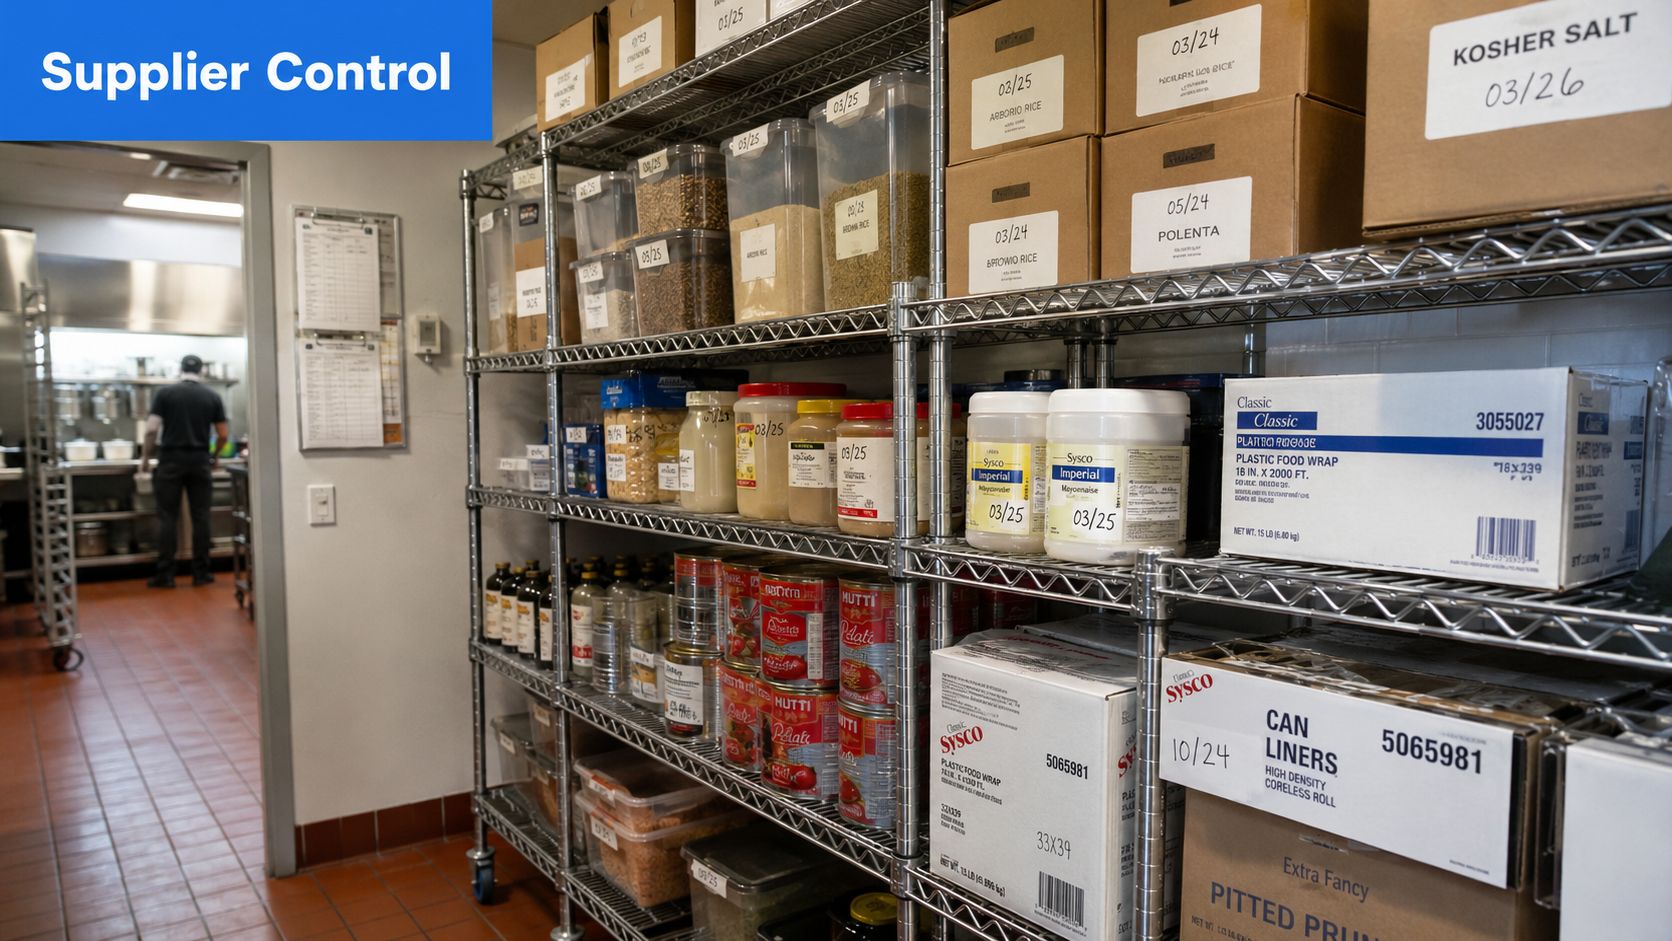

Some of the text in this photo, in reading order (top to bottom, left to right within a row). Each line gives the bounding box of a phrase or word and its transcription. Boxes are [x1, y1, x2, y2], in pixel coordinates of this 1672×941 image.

[1172, 26, 1219, 56] 03/24
[1453, 12, 1638, 66] KOSHER SALT
[1485, 67, 1584, 107] 03/26
[1024, 100, 1042, 113] RICE
[1167, 193, 1209, 215] 05/24
[995, 224, 1028, 244] 03/24
[1158, 225, 1220, 242] POLENTA
[1020, 253, 1037, 264] RICE
[1237, 396, 1272, 409] Classic
[1254, 412, 1298, 428] Classic
[1476, 412, 1544, 431] 3055027
[983, 457, 1004, 469] Sysco
[1067, 452, 1093, 465] Sysco
[1236, 454, 1339, 467] PLASTIC FOOD WRAP
[979, 470, 1010, 481] Imperial
[1060, 467, 1100, 481] Imperial
[1261, 468, 1267, 478] X
[1269, 468, 1293, 479] 2000
[1295, 469, 1309, 480] FT.
[989, 501, 1025, 523] 03/25
[1073, 507, 1117, 531] 03/25
[1266, 709, 1309, 738] CAN
[1172, 736, 1230, 769] 10/24
[1266, 737, 1339, 776] LINERS
[1382, 729, 1482, 774] 5065981
[1046, 753, 1089, 780] 5065981
[1265, 765, 1327, 791] HIGH DENSITY
[1265, 778, 1337, 808] CORELESS ROLL
[1283, 856, 1370, 903] Extra Fancy
[1211, 881, 1295, 930] PITTED
